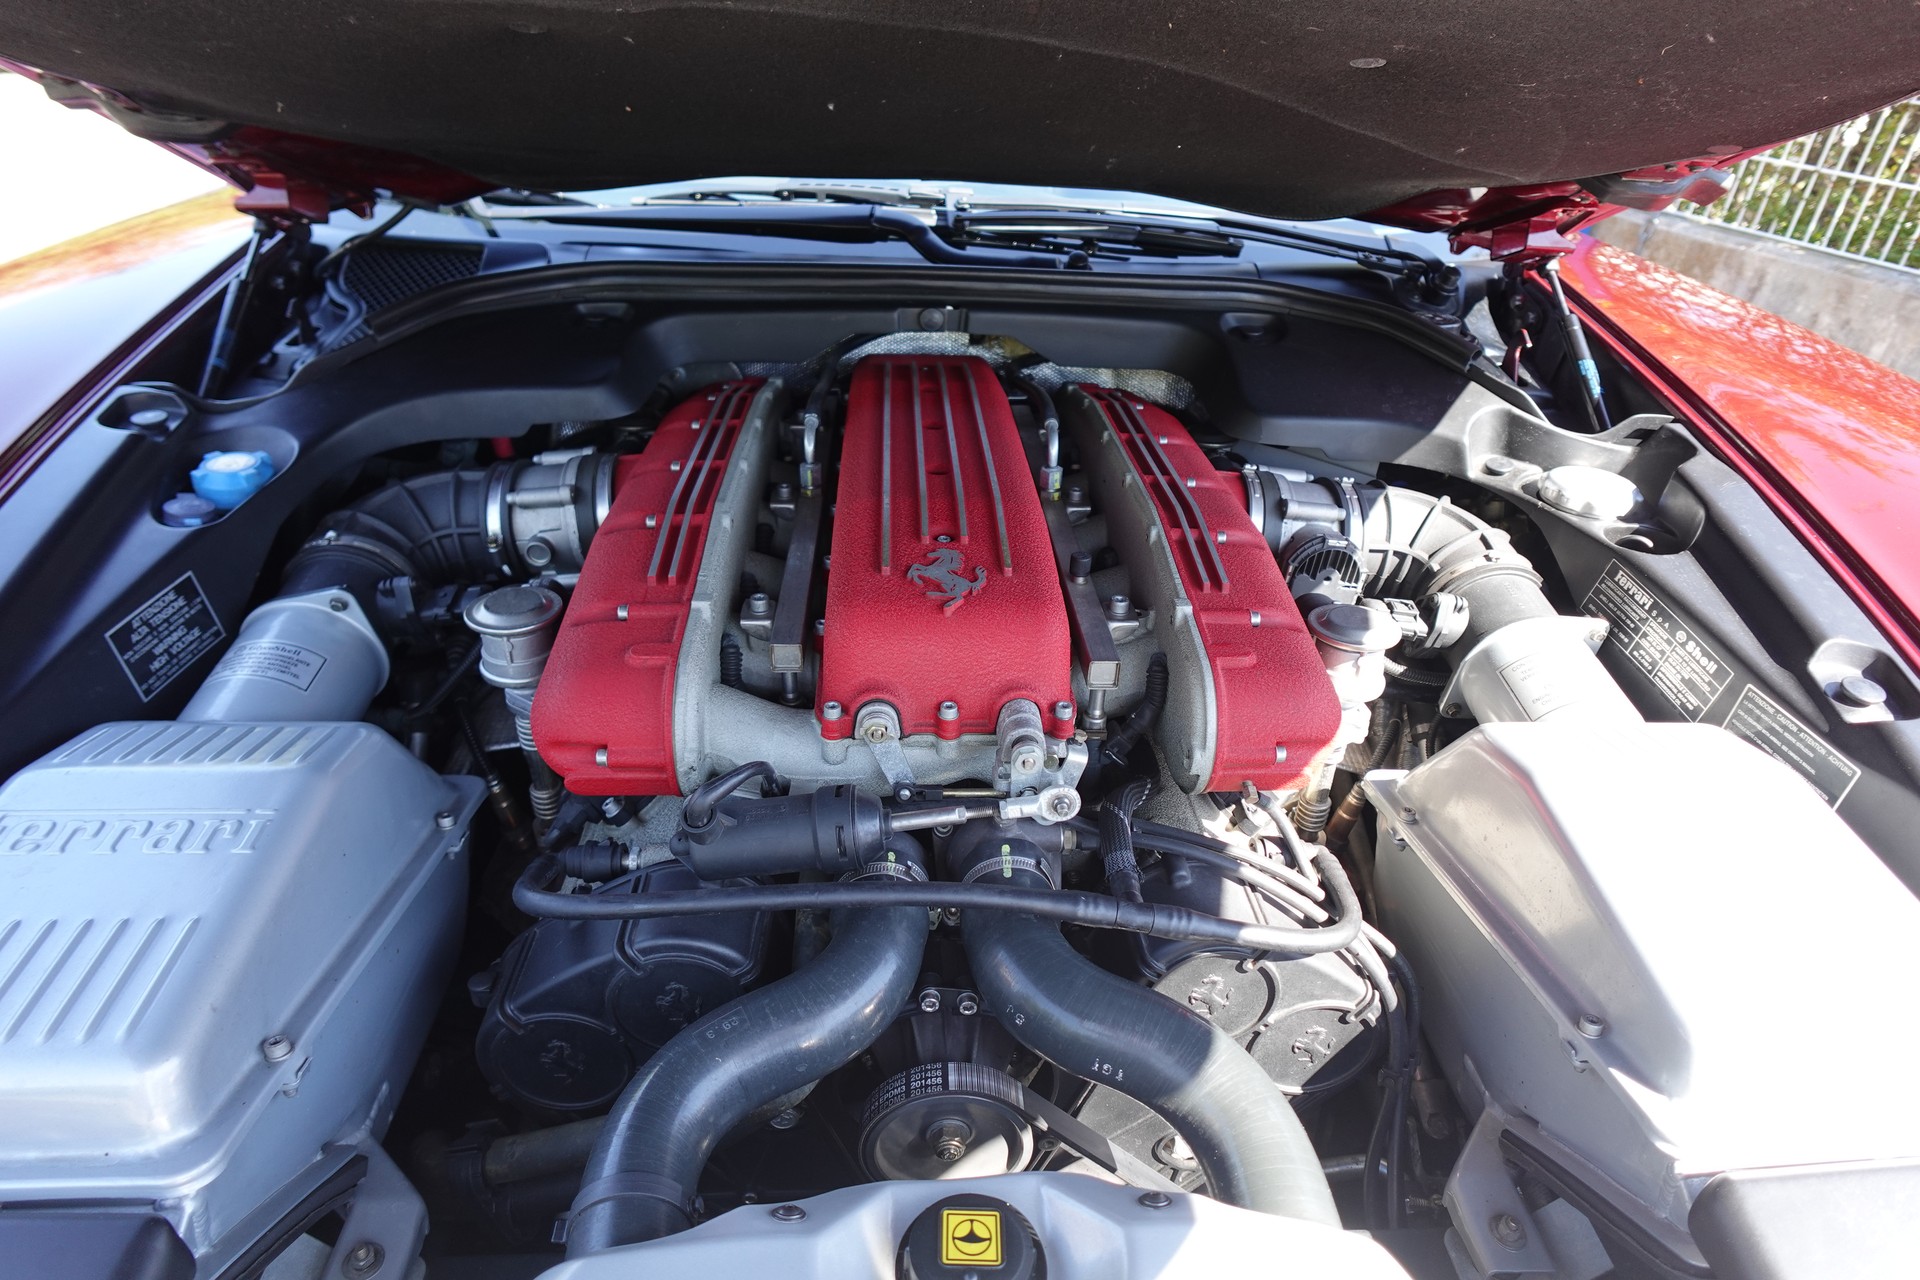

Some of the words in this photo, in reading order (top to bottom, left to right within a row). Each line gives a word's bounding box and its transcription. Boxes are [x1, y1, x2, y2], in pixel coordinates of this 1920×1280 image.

[1613, 568, 1653, 610] Ferrari
[1683, 638, 1718, 674] Shell
[1747, 690, 1775, 714] ATTENZIONE
[1776, 713, 1798, 732] CAUTION
[1798, 731, 1826, 755] ATTENTION
[1827, 754, 1853, 776] ACHTUNG
[880, 1078, 905, 1097] EPDM3
[911, 1070, 942, 1081] 201456
[880, 1086, 905, 1104] EPDM3
[911, 1077, 942, 1089] 201456
[911, 1085, 943, 1097] 201456
